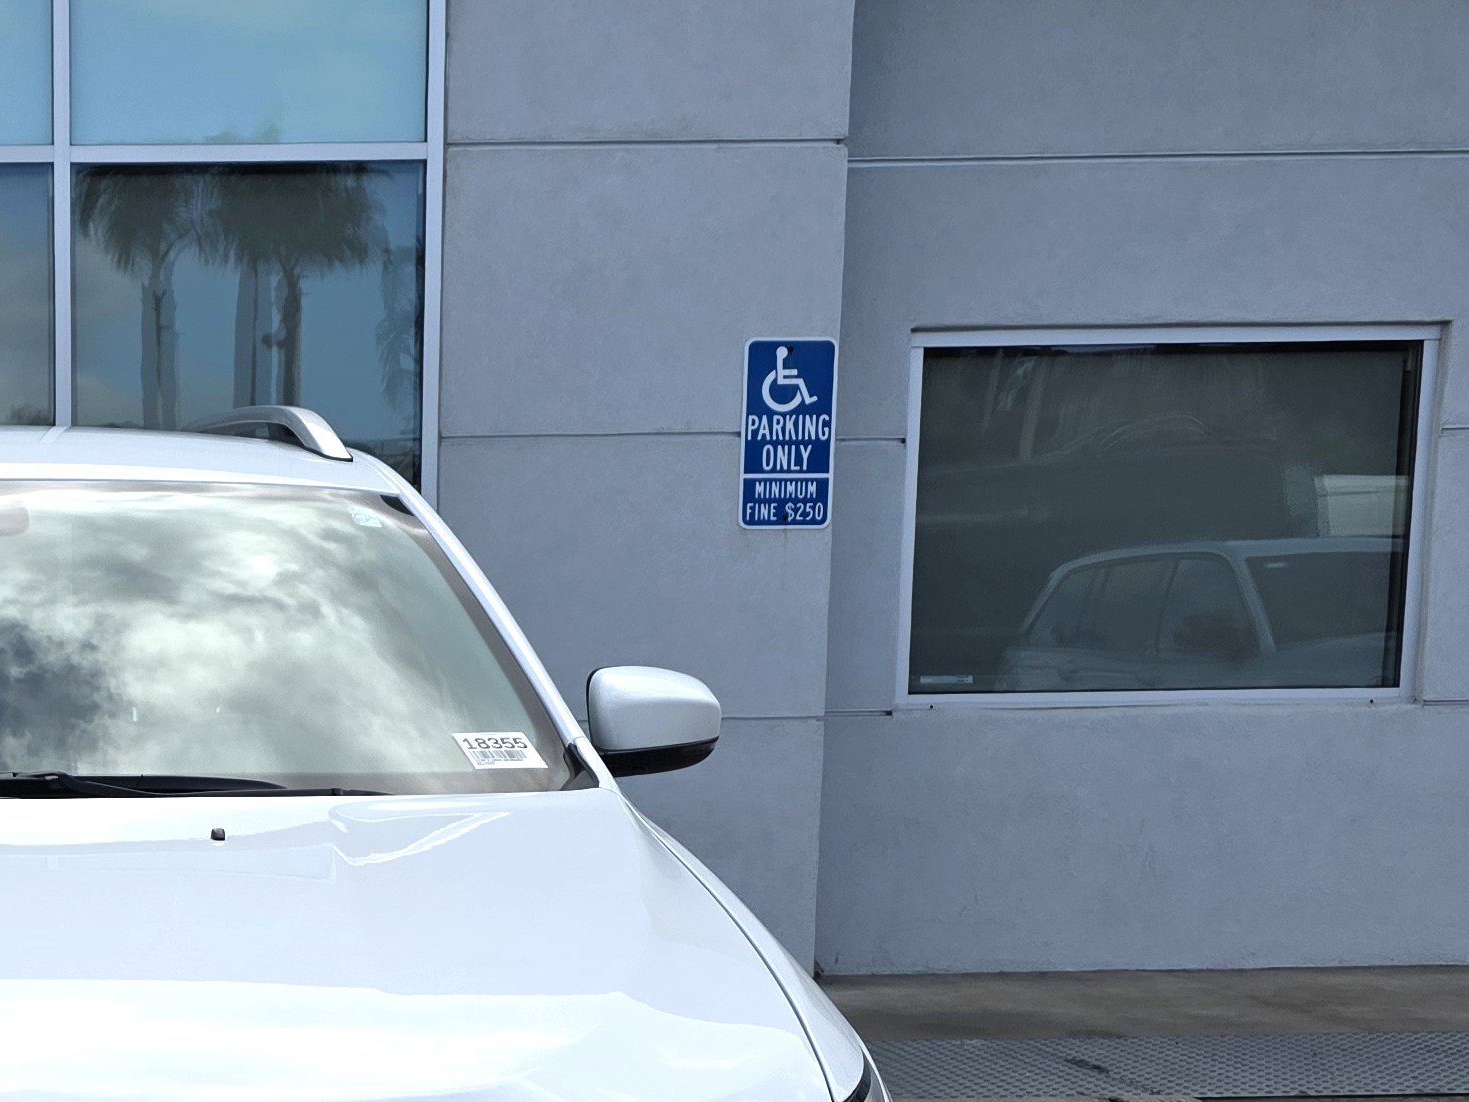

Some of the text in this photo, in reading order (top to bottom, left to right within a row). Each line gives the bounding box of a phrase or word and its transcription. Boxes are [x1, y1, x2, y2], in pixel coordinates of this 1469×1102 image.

[747, 414, 830, 441] PARKING
[762, 445, 812, 471] ONLY
[755, 481, 817, 499] MINIMUM
[746, 501, 824, 522] FINE $250
[462, 737, 528, 750] 18355
